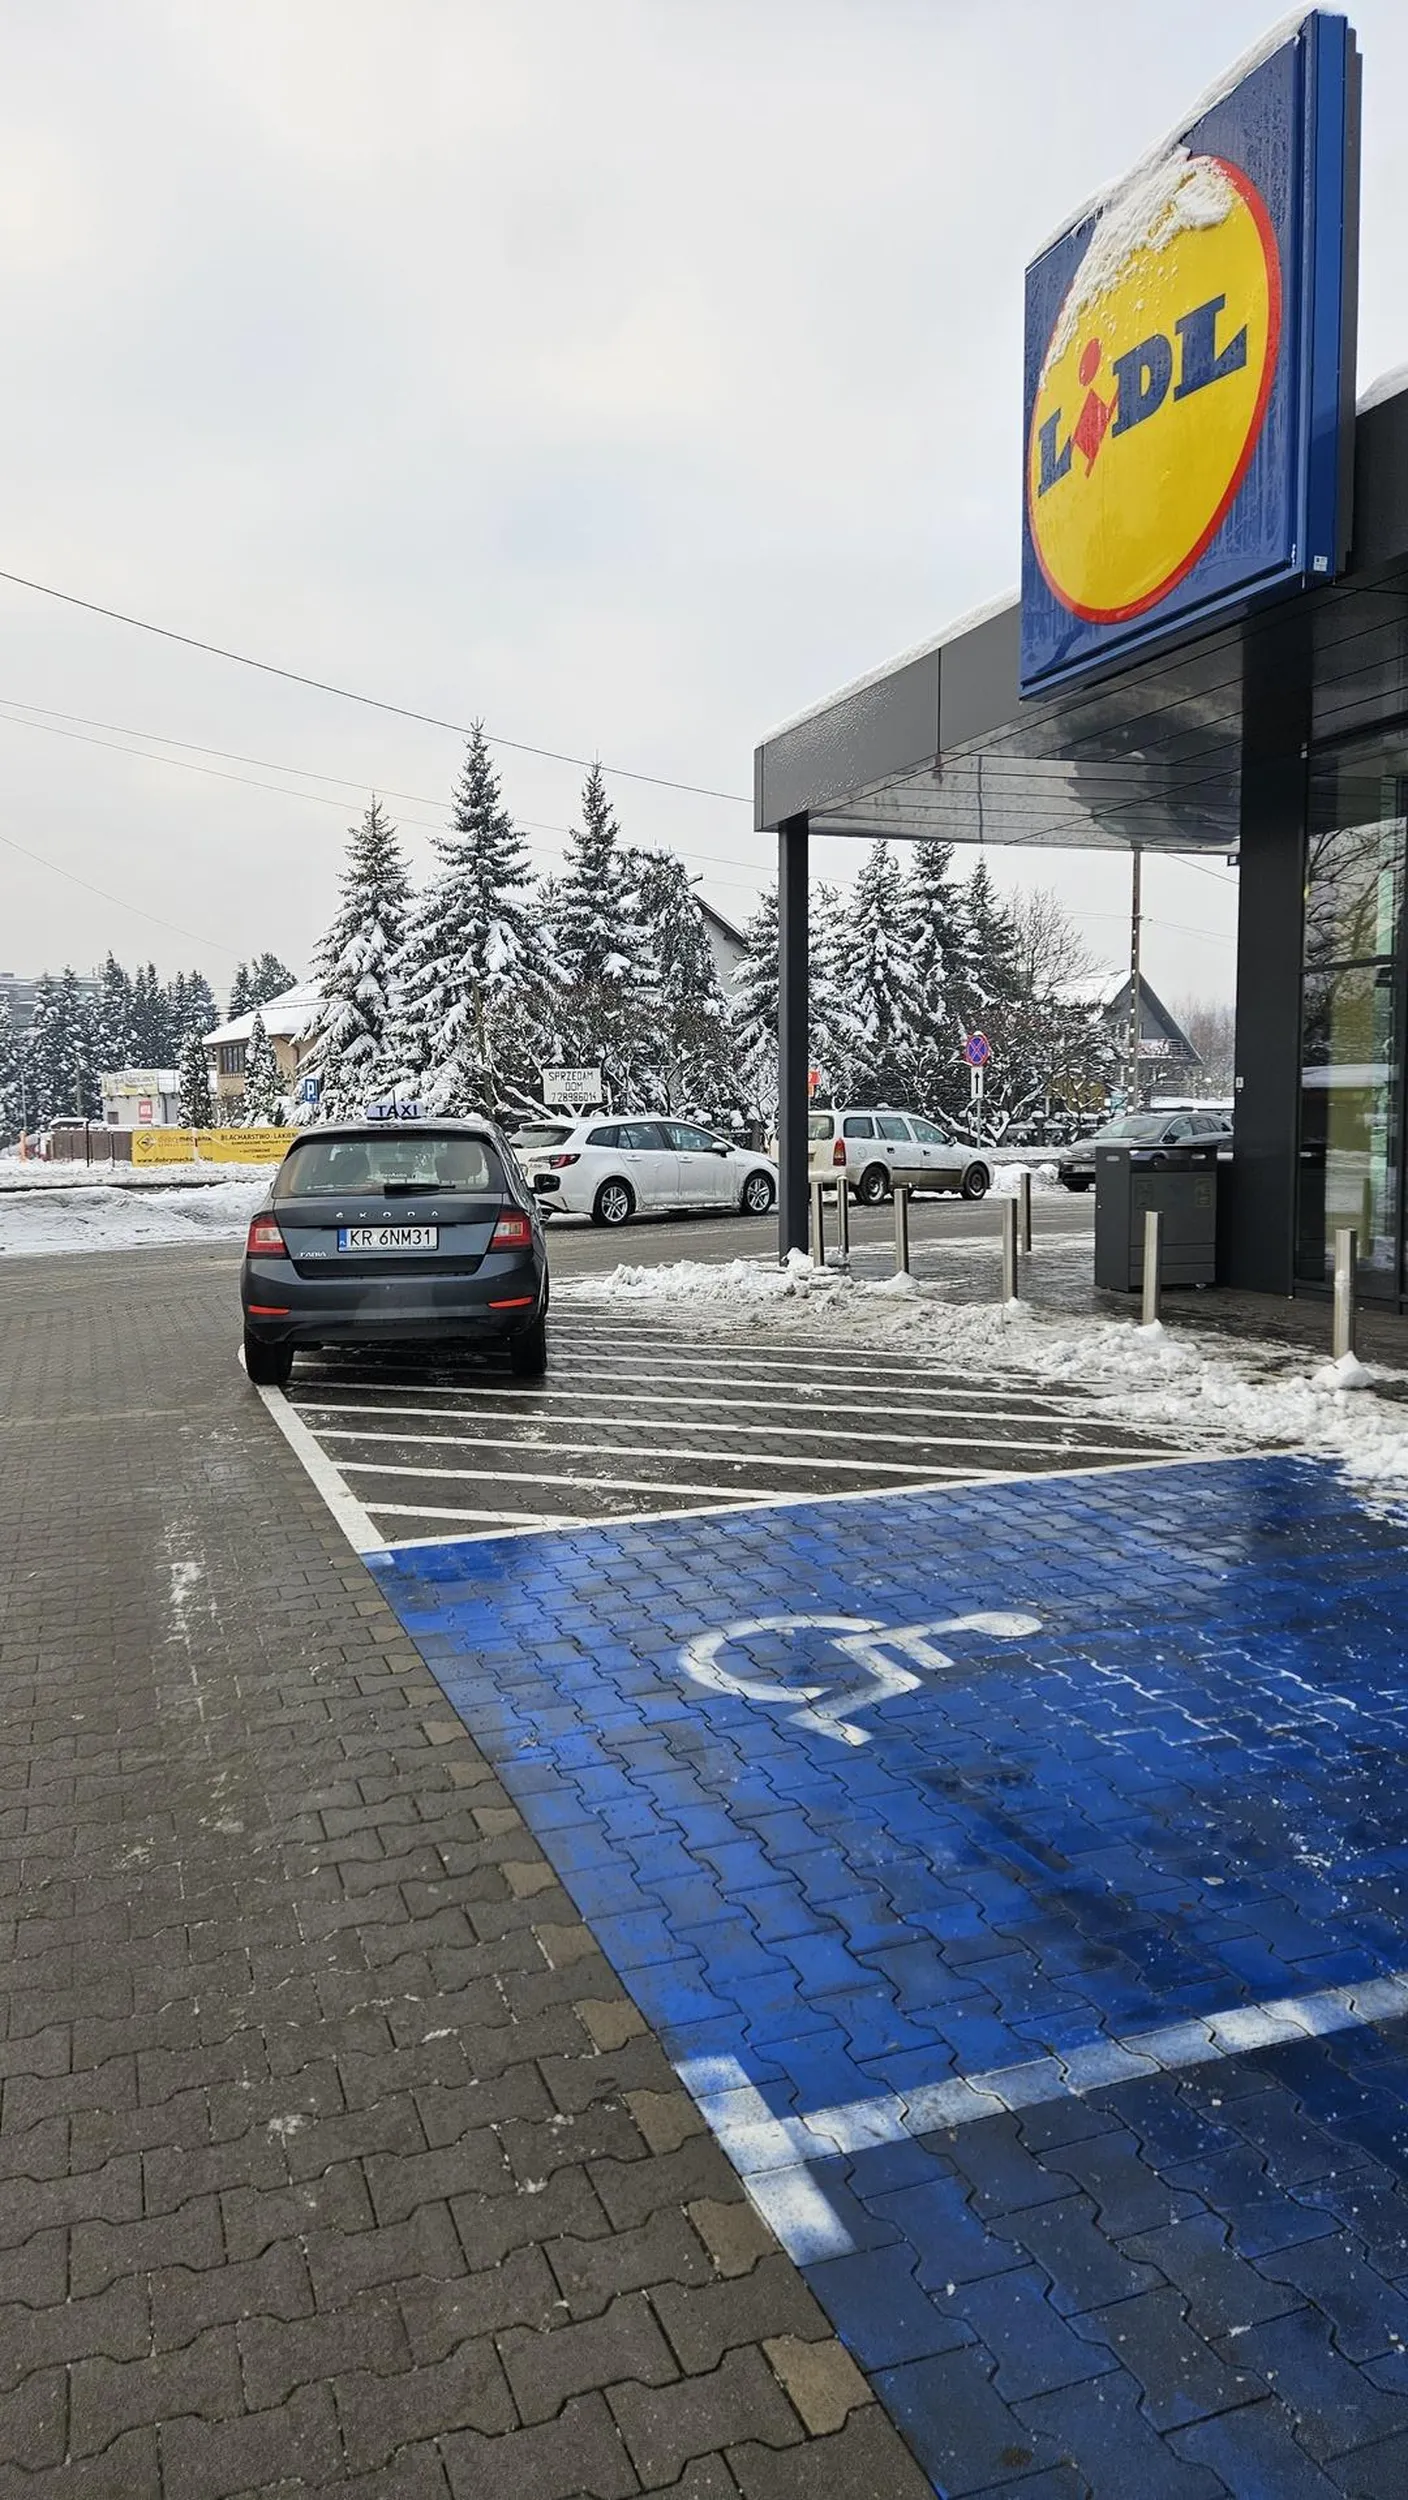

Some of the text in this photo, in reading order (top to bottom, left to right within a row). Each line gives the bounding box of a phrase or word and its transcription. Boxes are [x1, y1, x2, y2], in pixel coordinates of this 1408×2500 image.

[548, 1071, 594, 1081] SPRZEDAM
[565, 1082, 584, 1091] DOM
[376, 1105, 418, 1117] TAXI
[350, 1229, 430, 1246] KR 6NM31
